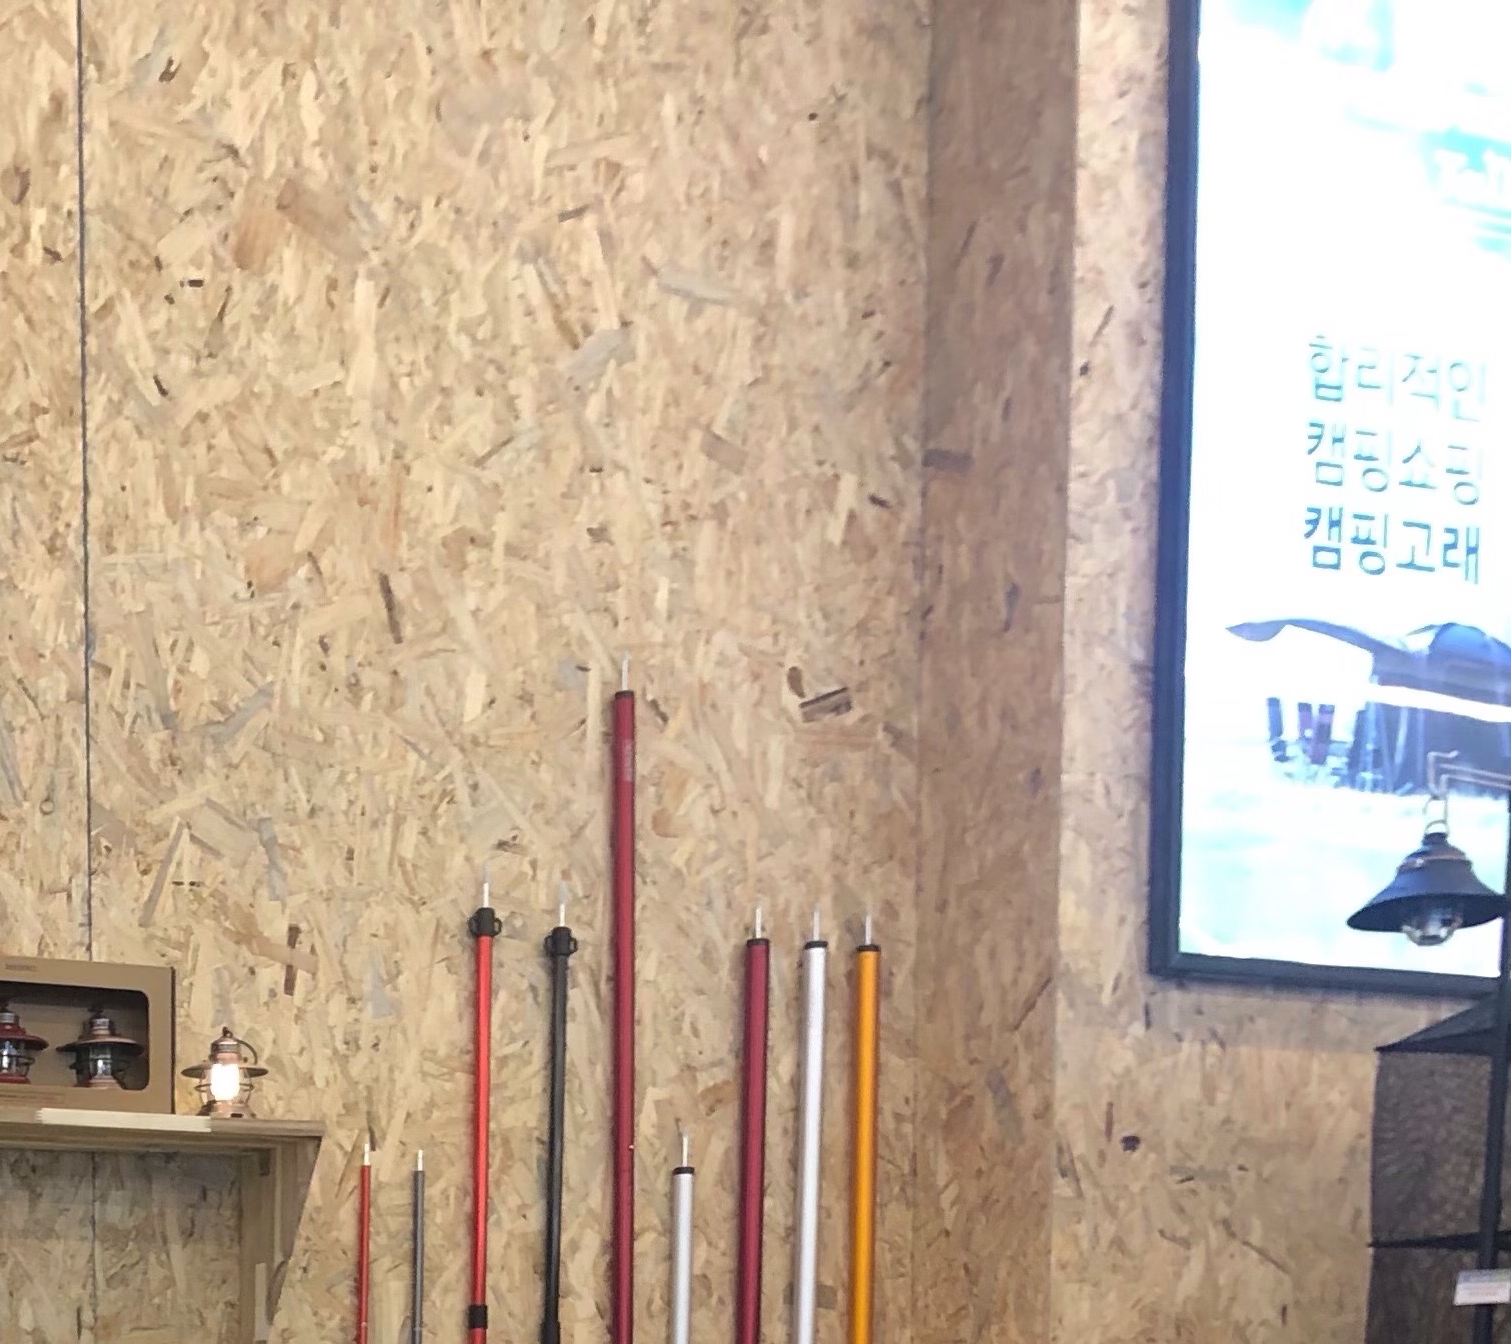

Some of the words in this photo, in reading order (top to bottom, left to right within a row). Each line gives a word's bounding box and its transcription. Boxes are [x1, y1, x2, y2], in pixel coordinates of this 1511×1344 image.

[1308, 334, 1486, 422] 합리적인
[1307, 421, 1482, 506] 캠핑쇼핑
[1304, 506, 1480, 585] 캠핑고래
